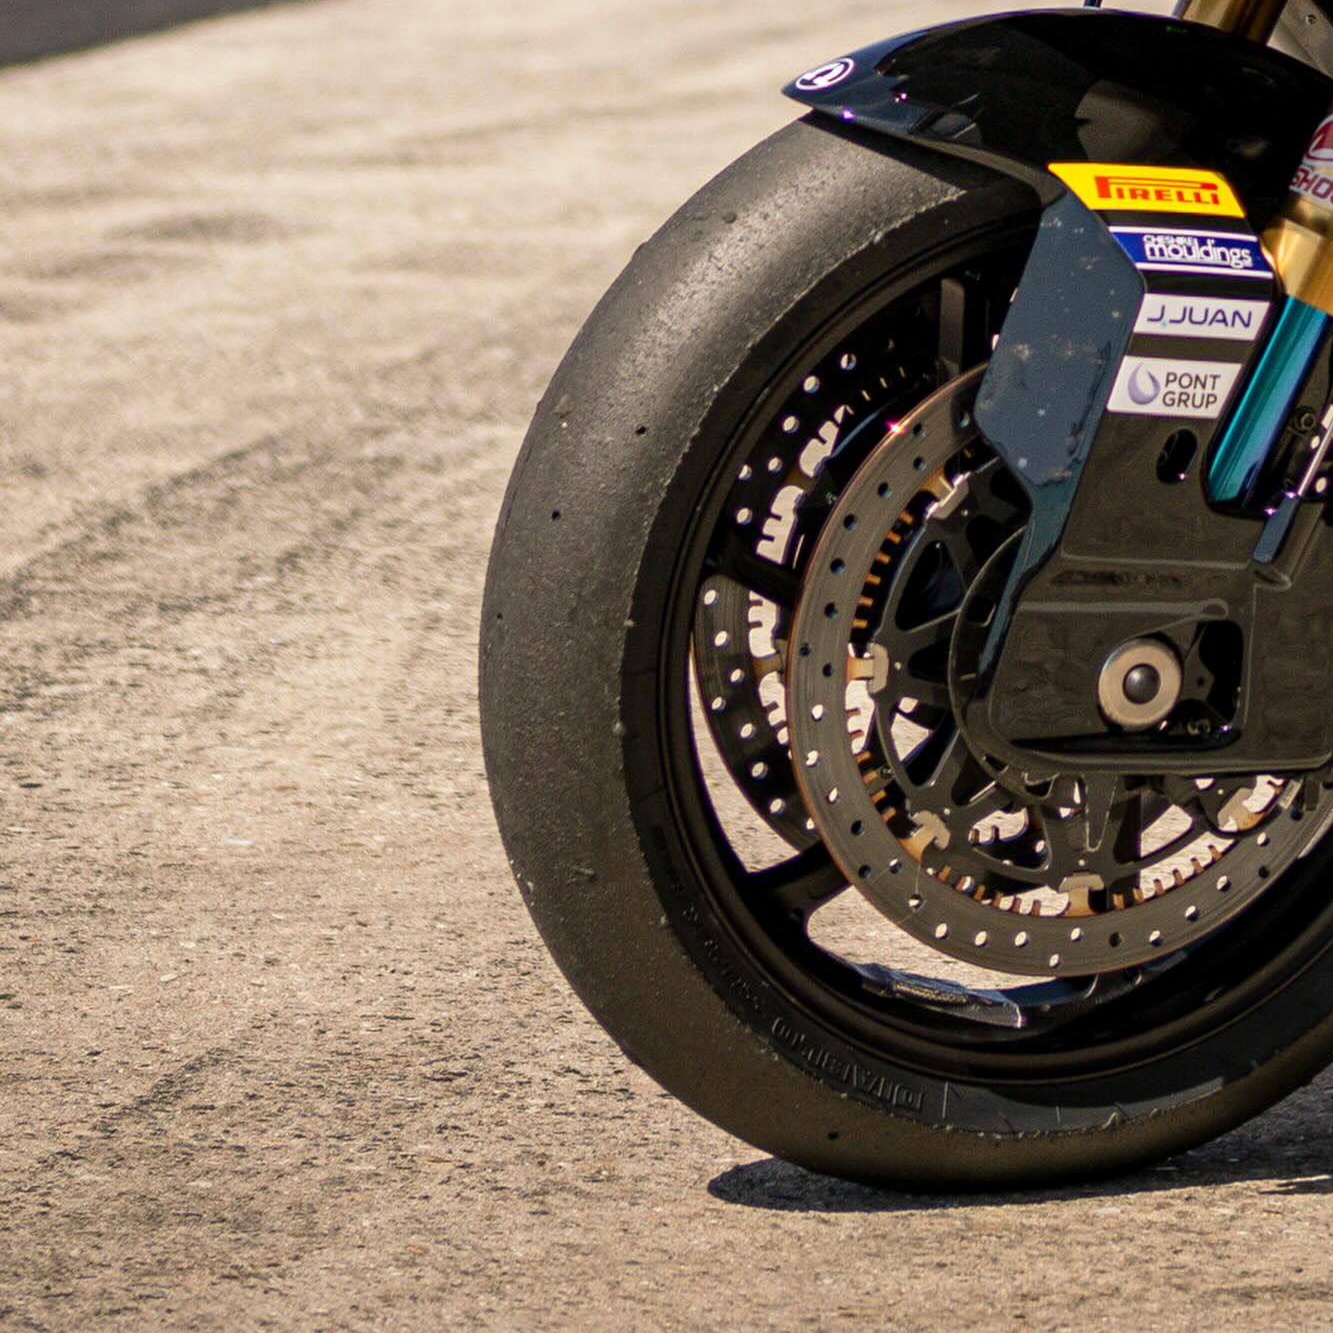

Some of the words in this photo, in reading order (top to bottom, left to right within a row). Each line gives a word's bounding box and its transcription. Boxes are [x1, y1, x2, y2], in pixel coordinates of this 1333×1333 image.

[1094, 175, 1221, 206] PIRELLI
[1143, 238, 1254, 270] mouldings
[1164, 371, 1222, 390] PONT
[1161, 390, 1219, 410] GRUP
